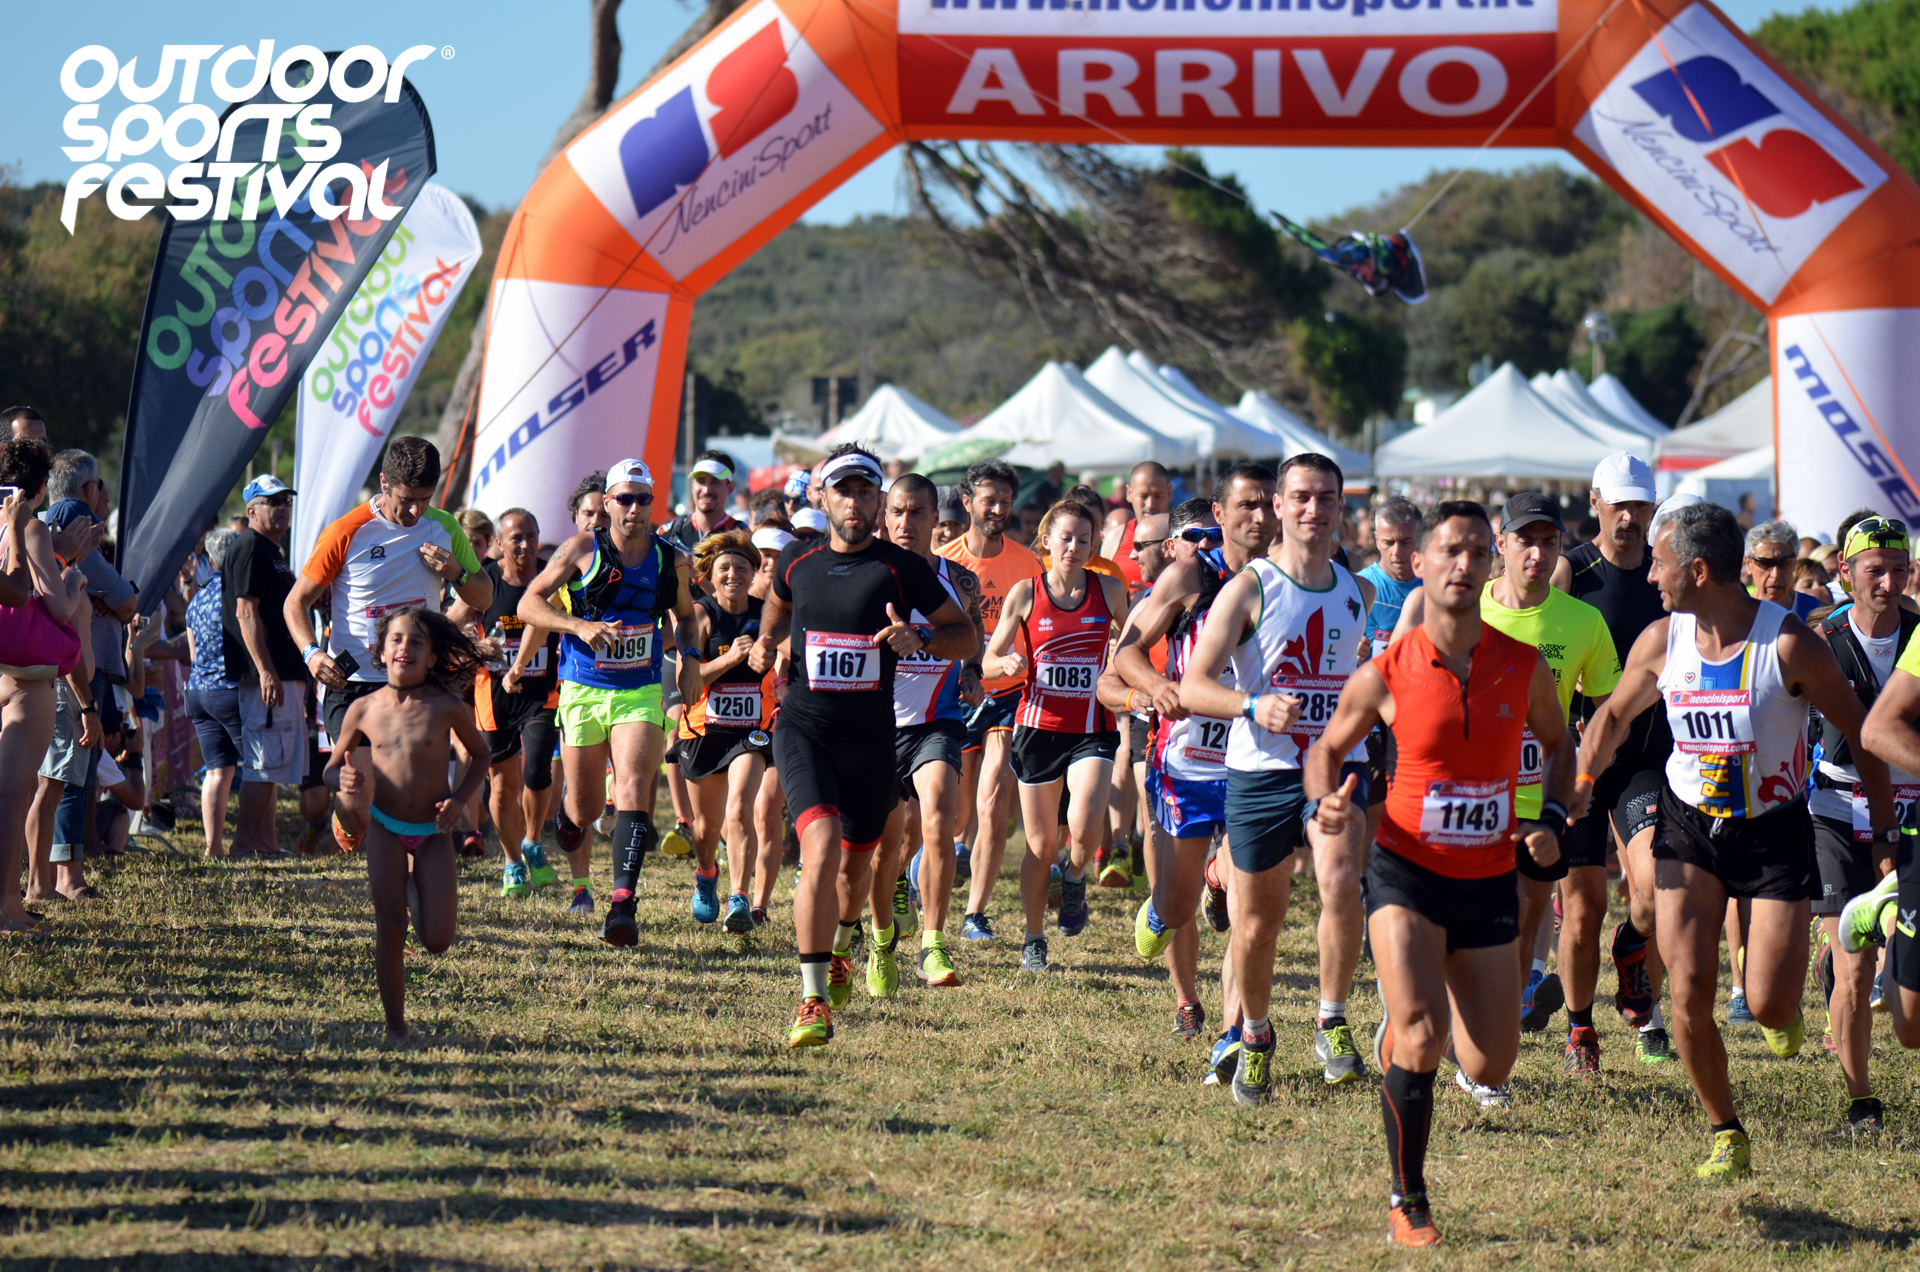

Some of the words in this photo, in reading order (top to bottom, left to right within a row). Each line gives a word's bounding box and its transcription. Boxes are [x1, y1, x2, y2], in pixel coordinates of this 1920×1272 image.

[944, 46, 1509, 118] ARRIVO
[1784, 344, 1920, 531] MOSE
[604, 636, 647, 660] 1099
[1055, 655, 1098, 664] nencinisport
[816, 650, 867, 678] 1167
[722, 685, 760, 694] nencinisport
[1046, 666, 1092, 689] 1083
[1295, 678, 1347, 690] nencinispor
[714, 696, 754, 718] 1250
[1286, 692, 1339, 722] 285
[1689, 693, 1746, 705] nencinisport
[1200, 721, 1232, 750] 12
[1682, 711, 1736, 740] 1011
[1681, 742, 1750, 754] nencinisport.com
[1441, 799, 1499, 832] 1143
